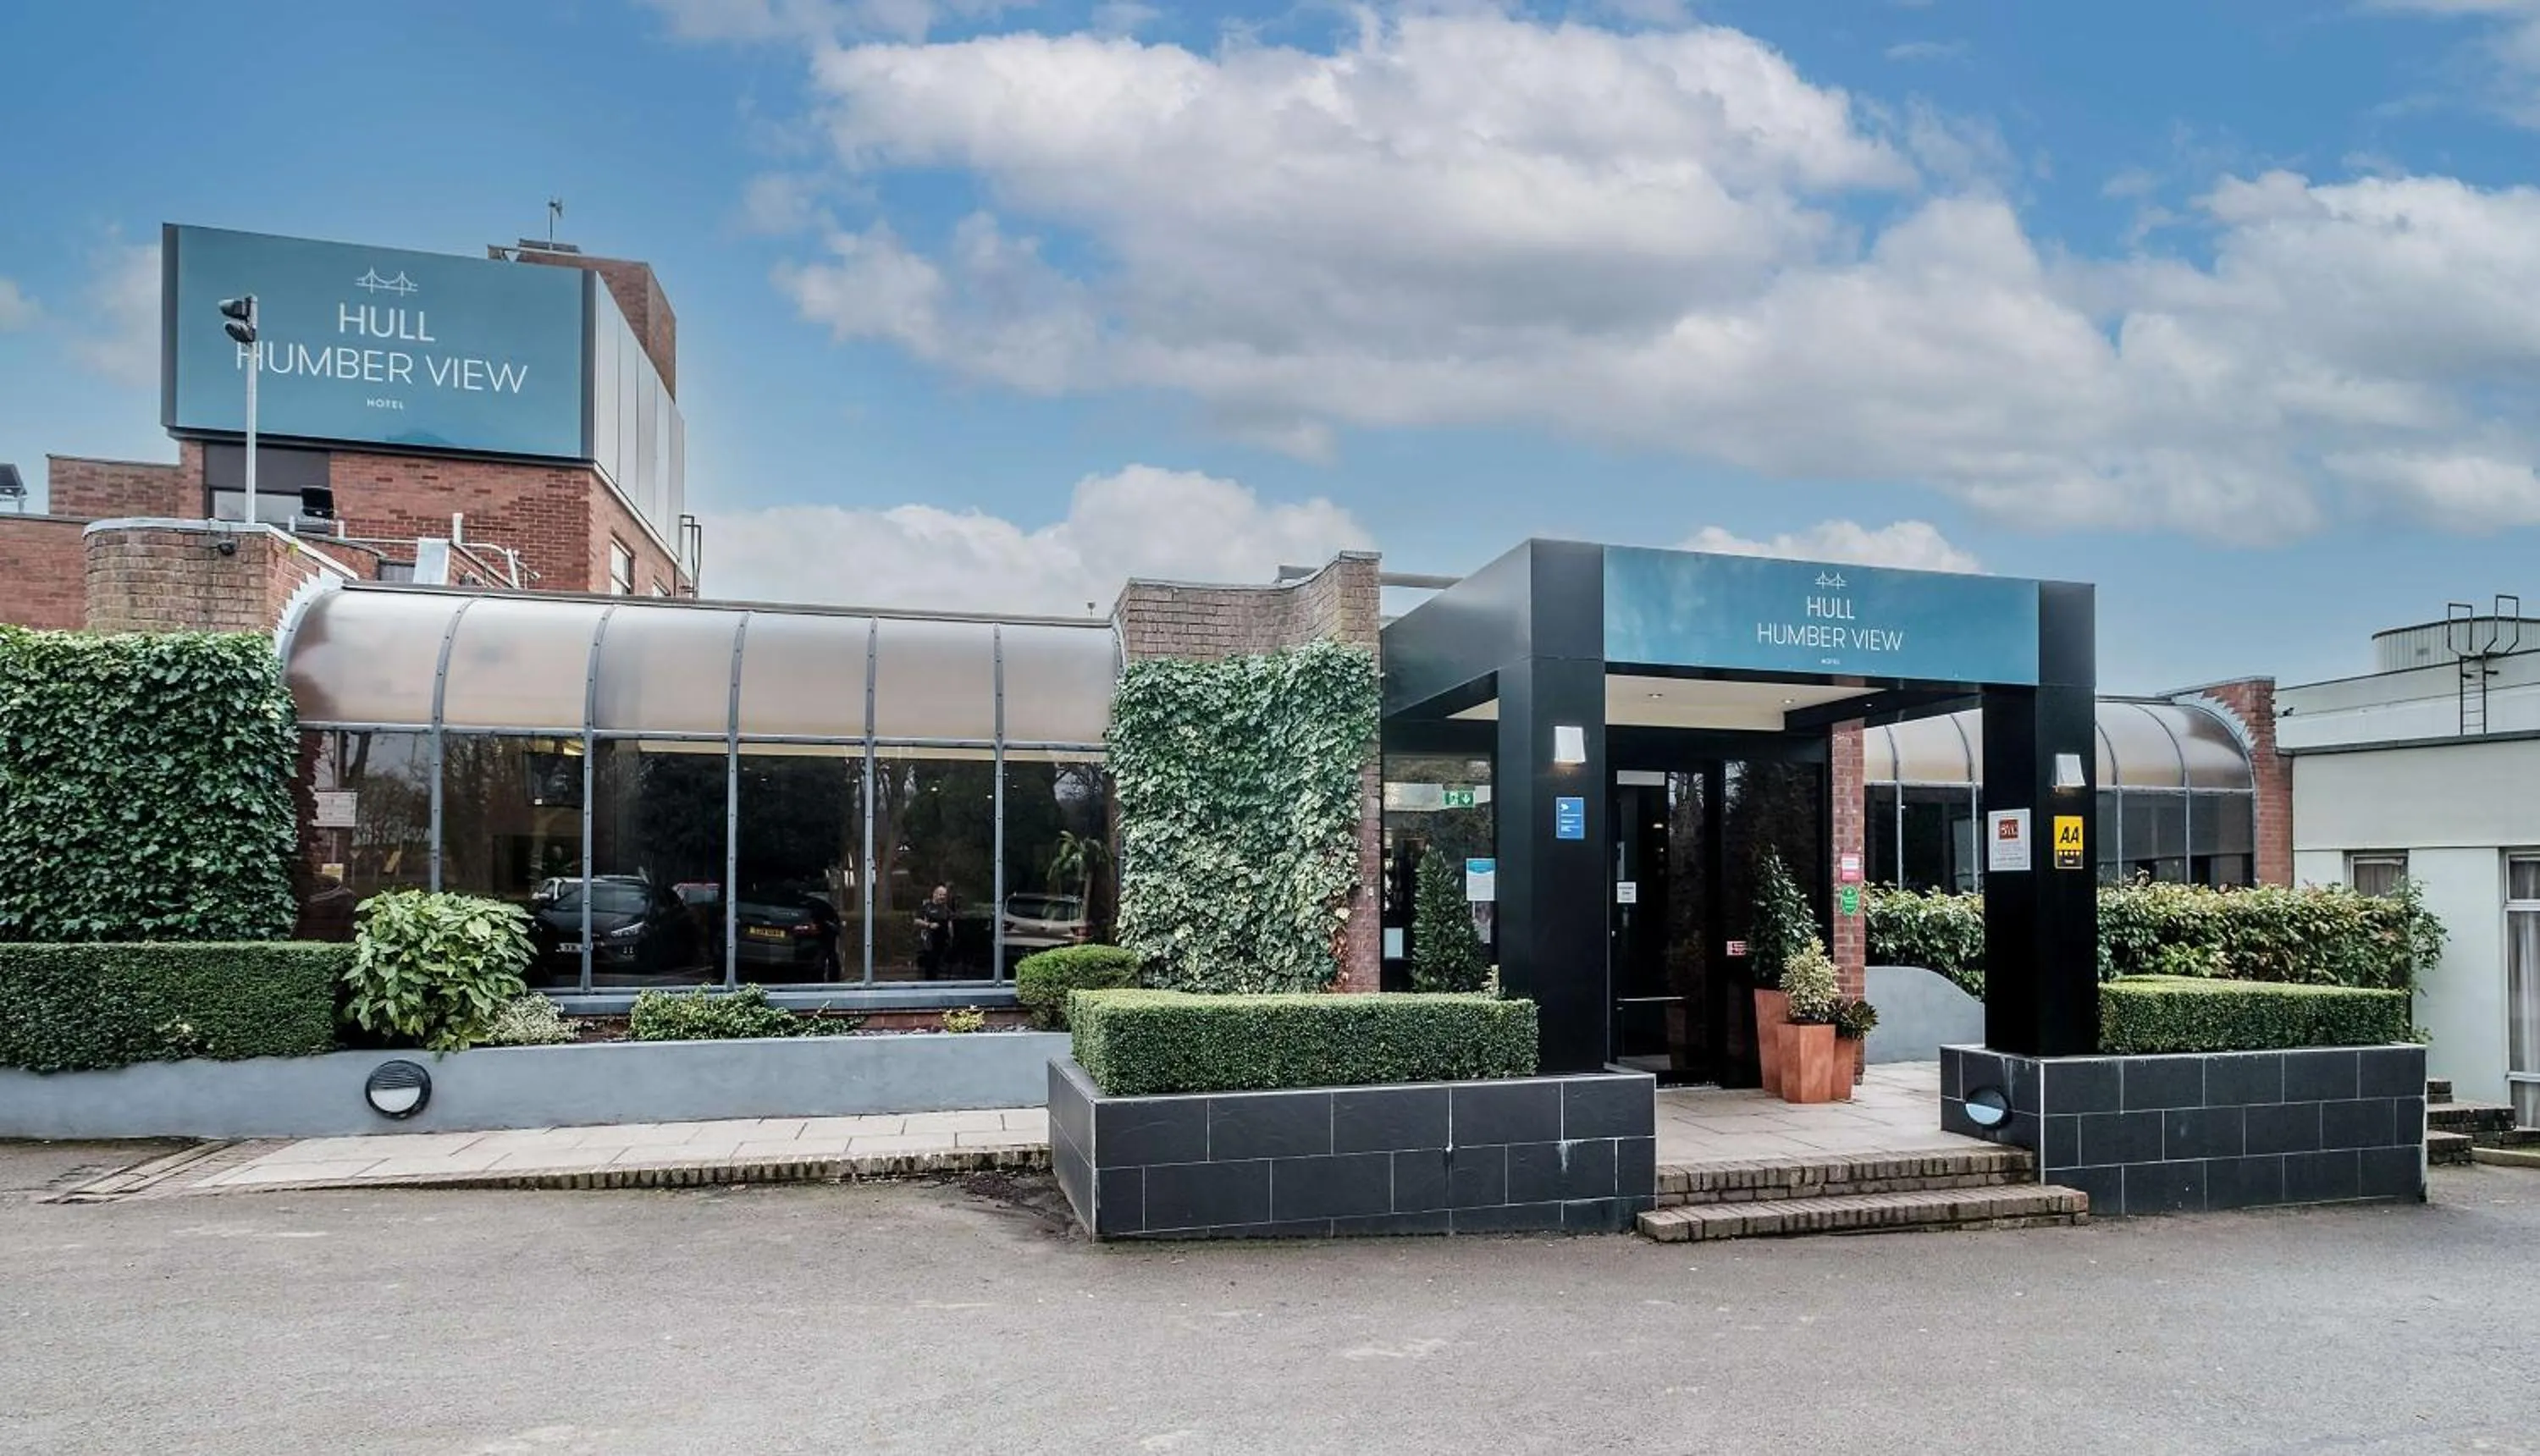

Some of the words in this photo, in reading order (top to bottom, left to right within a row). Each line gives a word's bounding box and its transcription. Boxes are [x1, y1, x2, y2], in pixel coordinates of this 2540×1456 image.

[340, 302, 435, 341] HULL
[236, 340, 413, 385] HUMBER
[425, 355, 527, 394] VIEW
[366, 398, 404, 410] HOTEL
[1806, 595, 1856, 620] HULL
[1757, 622, 1846, 649] HUMBER
[1850, 627, 1903, 651] VIEW
[2059, 825, 2080, 843] AA
